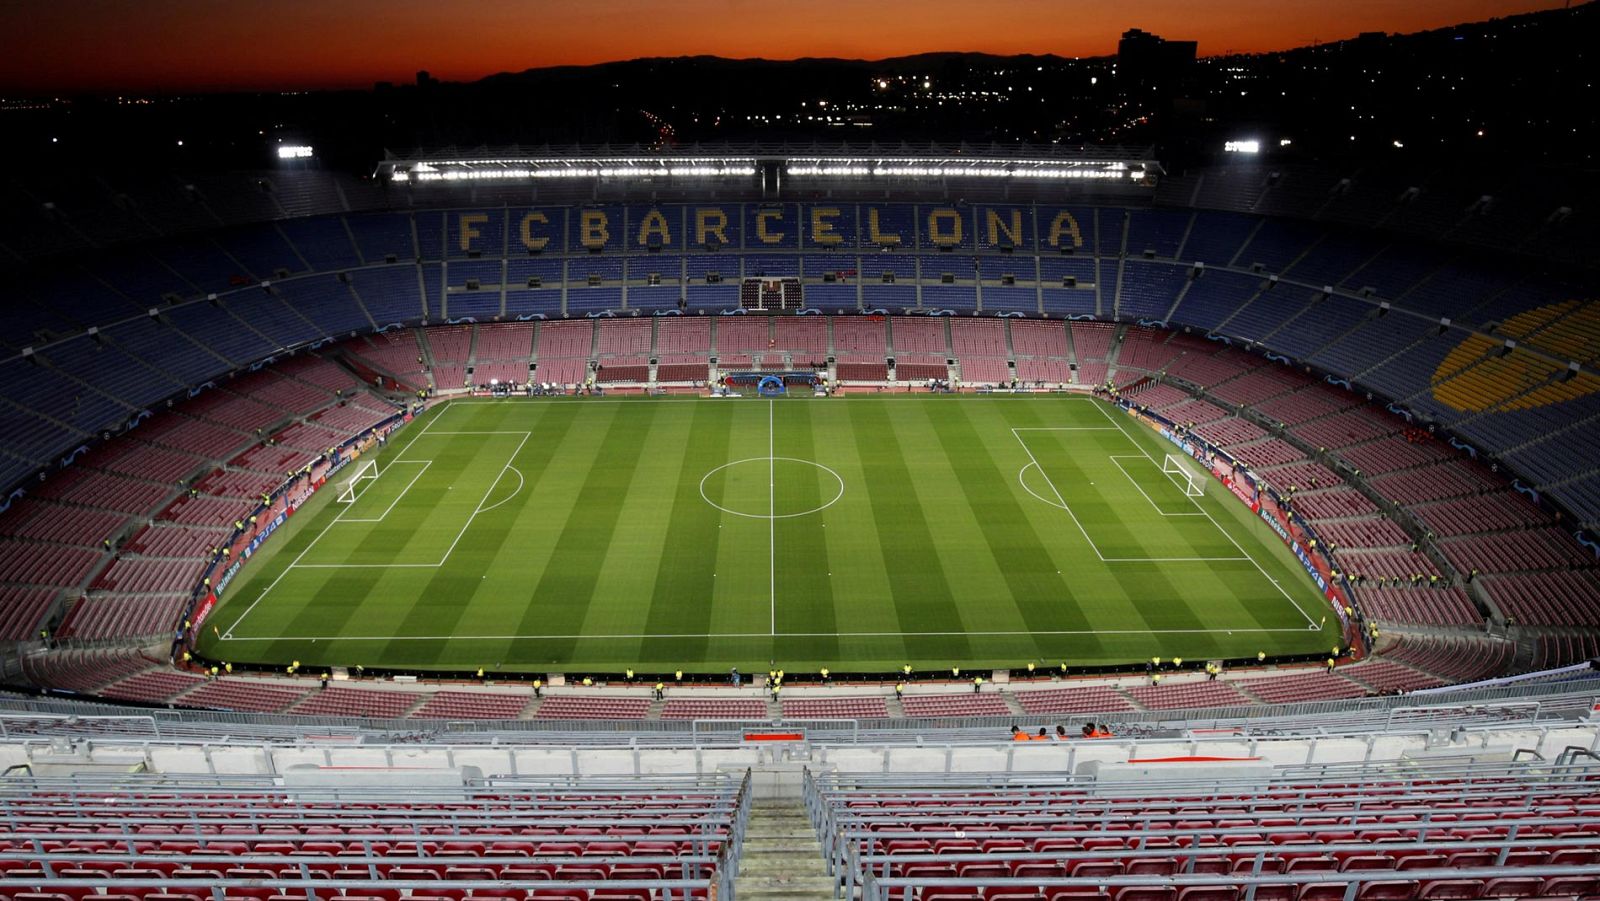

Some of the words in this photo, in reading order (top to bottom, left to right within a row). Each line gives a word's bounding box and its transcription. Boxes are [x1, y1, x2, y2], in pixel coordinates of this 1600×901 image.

[292, 486, 314, 511] NISSAN
[260, 521, 277, 542] PS4
[1261, 509, 1287, 539] Heineken
[216, 562, 240, 595] Heineken
[1303, 558, 1319, 581] PS4
